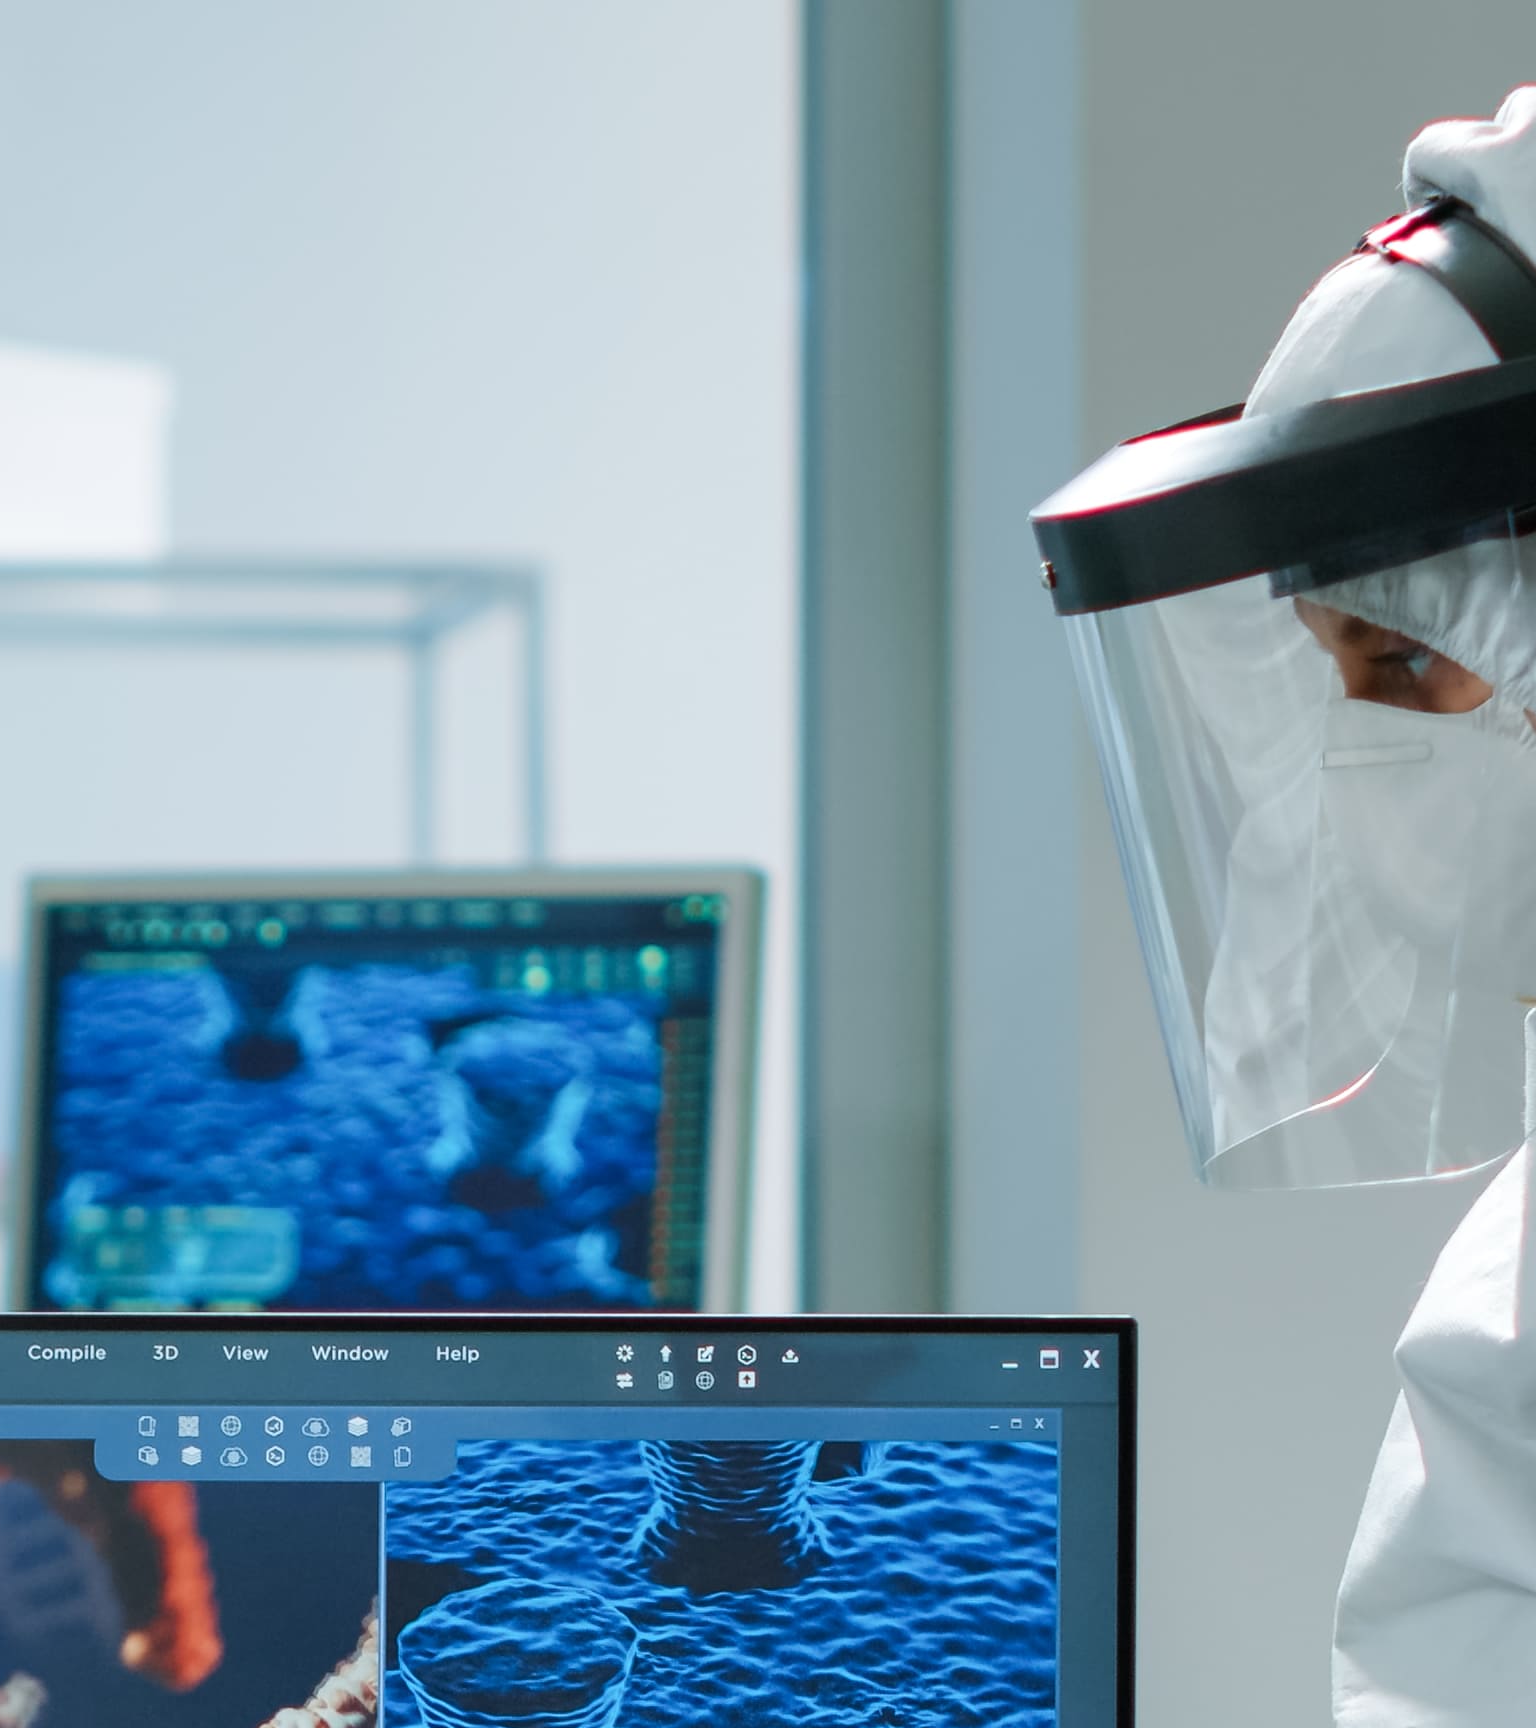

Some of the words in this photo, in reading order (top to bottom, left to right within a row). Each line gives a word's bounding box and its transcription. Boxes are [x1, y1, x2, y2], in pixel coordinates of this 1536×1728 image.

[27, 1344, 107, 1363] Compile
[153, 1345, 179, 1361] 3D
[222, 1345, 269, 1361] View
[311, 1345, 389, 1361] Window
[436, 1345, 480, 1364] Help
